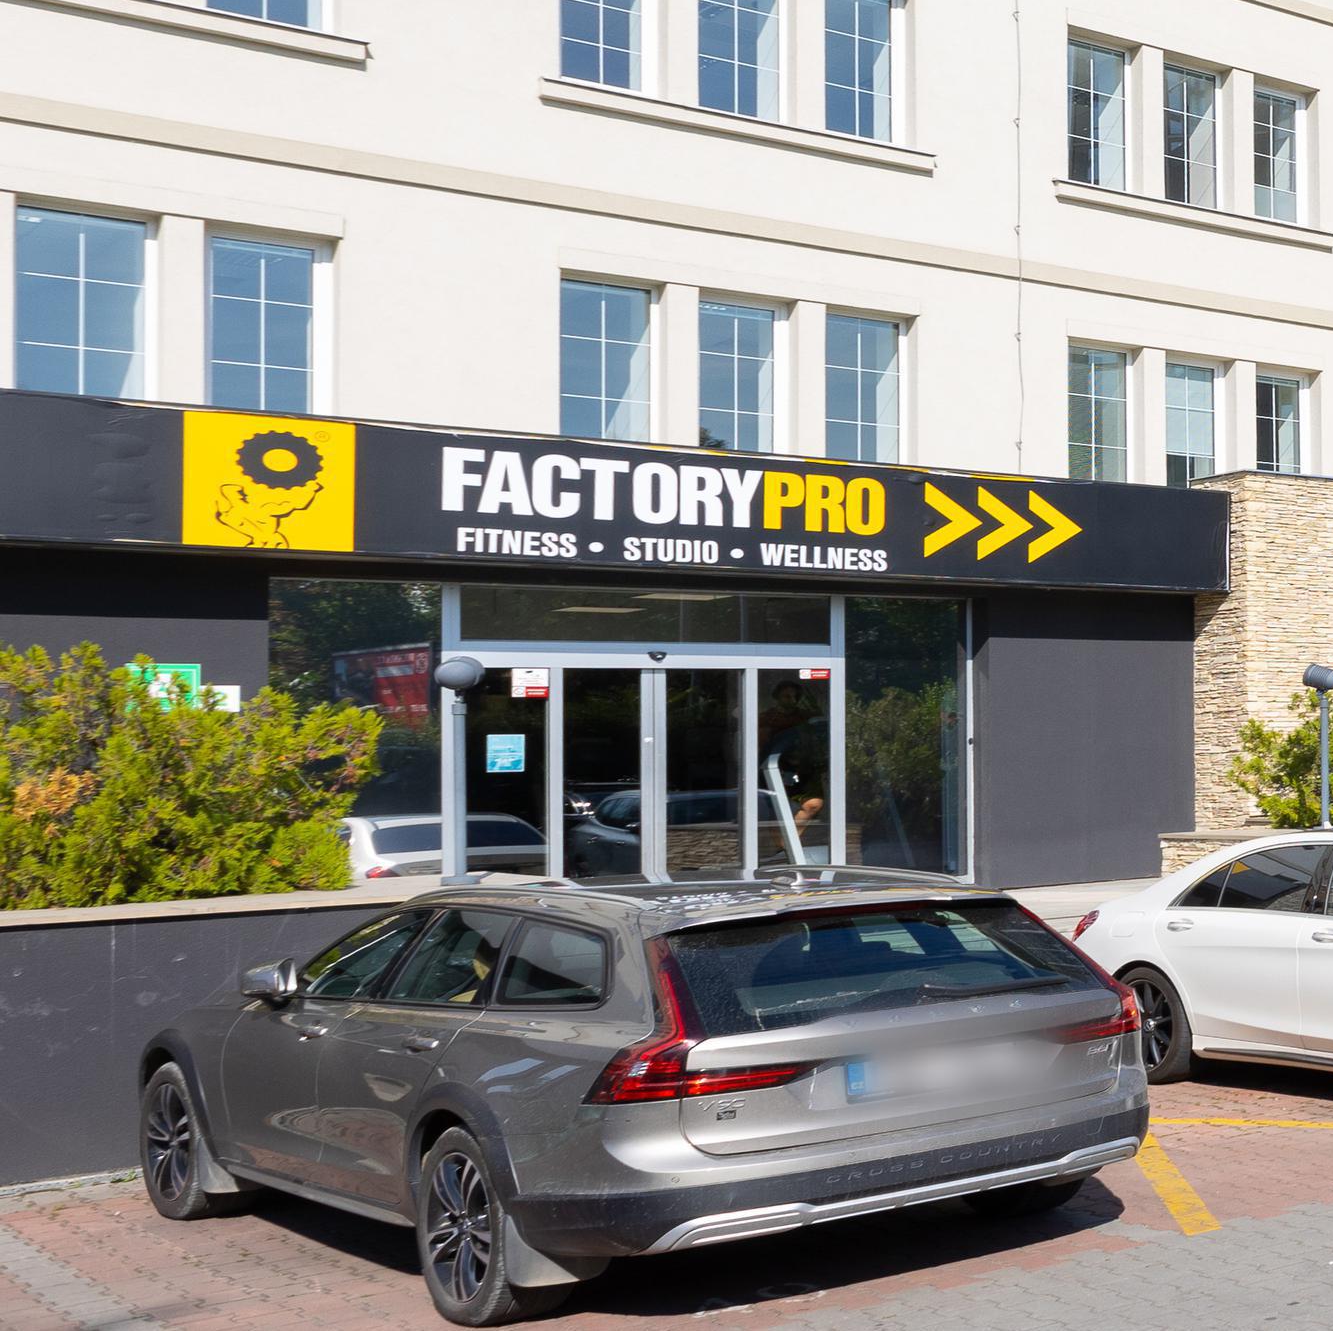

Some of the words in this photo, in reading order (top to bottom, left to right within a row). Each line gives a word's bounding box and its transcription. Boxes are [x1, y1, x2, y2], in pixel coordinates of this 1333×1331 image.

[441, 446, 886, 536] FACTORYPRO
[456, 527, 578, 558] FITNESS
[623, 536, 719, 564] STUDIO
[760, 542, 888, 572] WELLNESS
[825, 1159, 925, 1184] CROSS
[940, 1133, 1063, 1164] COUNTRY
